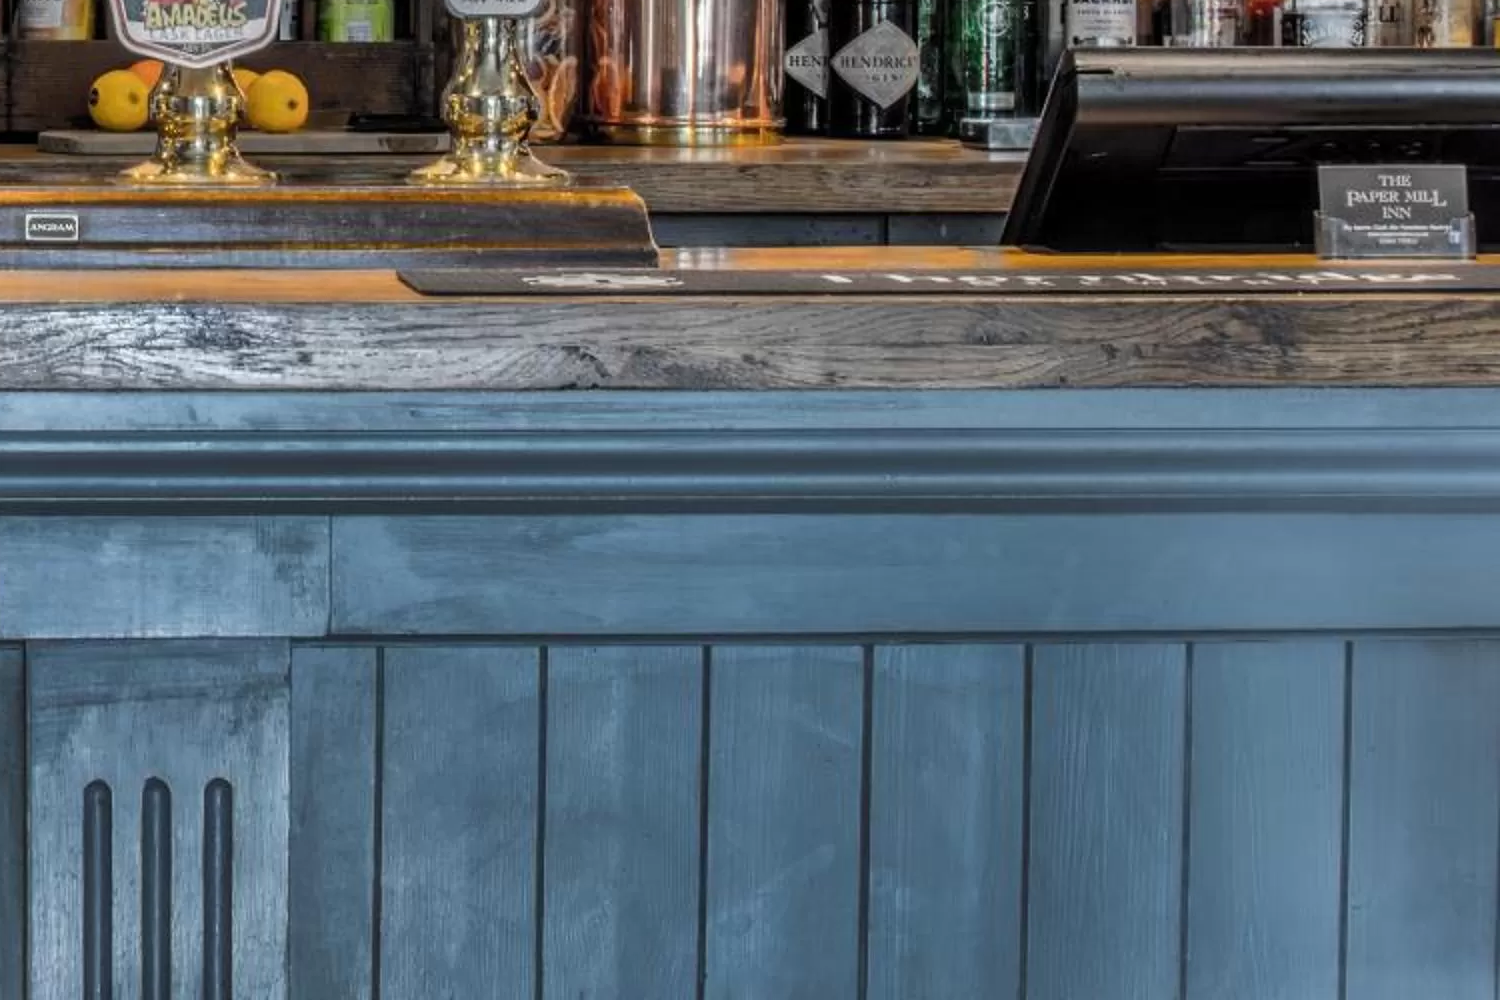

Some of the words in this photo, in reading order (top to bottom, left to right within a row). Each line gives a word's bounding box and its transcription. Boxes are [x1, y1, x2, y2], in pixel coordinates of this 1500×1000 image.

[145, 0, 248, 29] AMADEUS
[1377, 174, 1412, 187] THE
[1346, 189, 1400, 207] PAPER
[1404, 189, 1448, 207] MILL
[1382, 206, 1412, 219] INN
